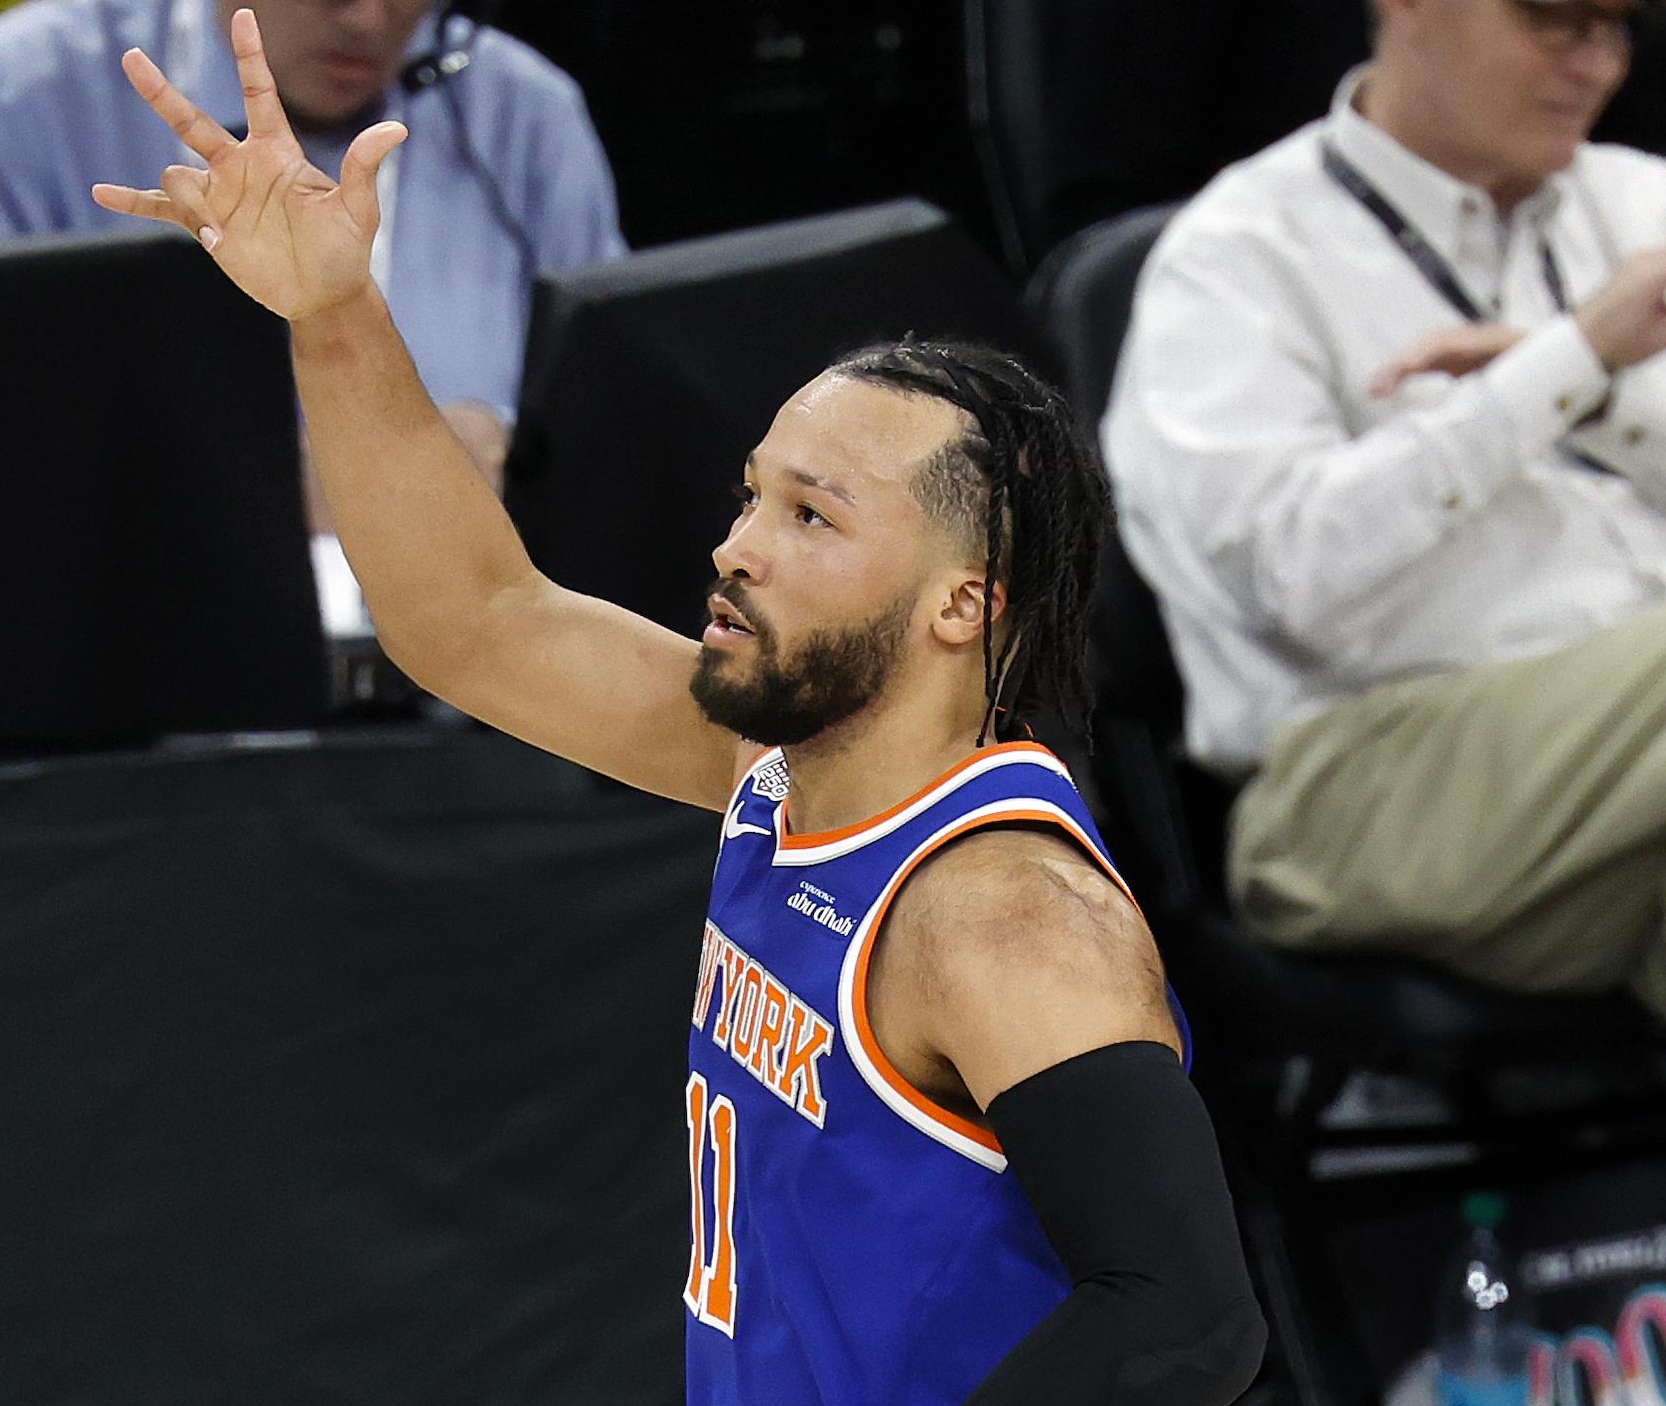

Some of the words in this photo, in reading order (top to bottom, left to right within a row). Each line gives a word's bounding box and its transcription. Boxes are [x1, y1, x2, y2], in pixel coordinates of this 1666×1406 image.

[758, 767, 789, 798] 250
[787, 892, 817, 916] abu
[813, 905, 857, 936] dhabi
[712, 937, 835, 1130] YORK
[683, 1070, 737, 1340] 11
